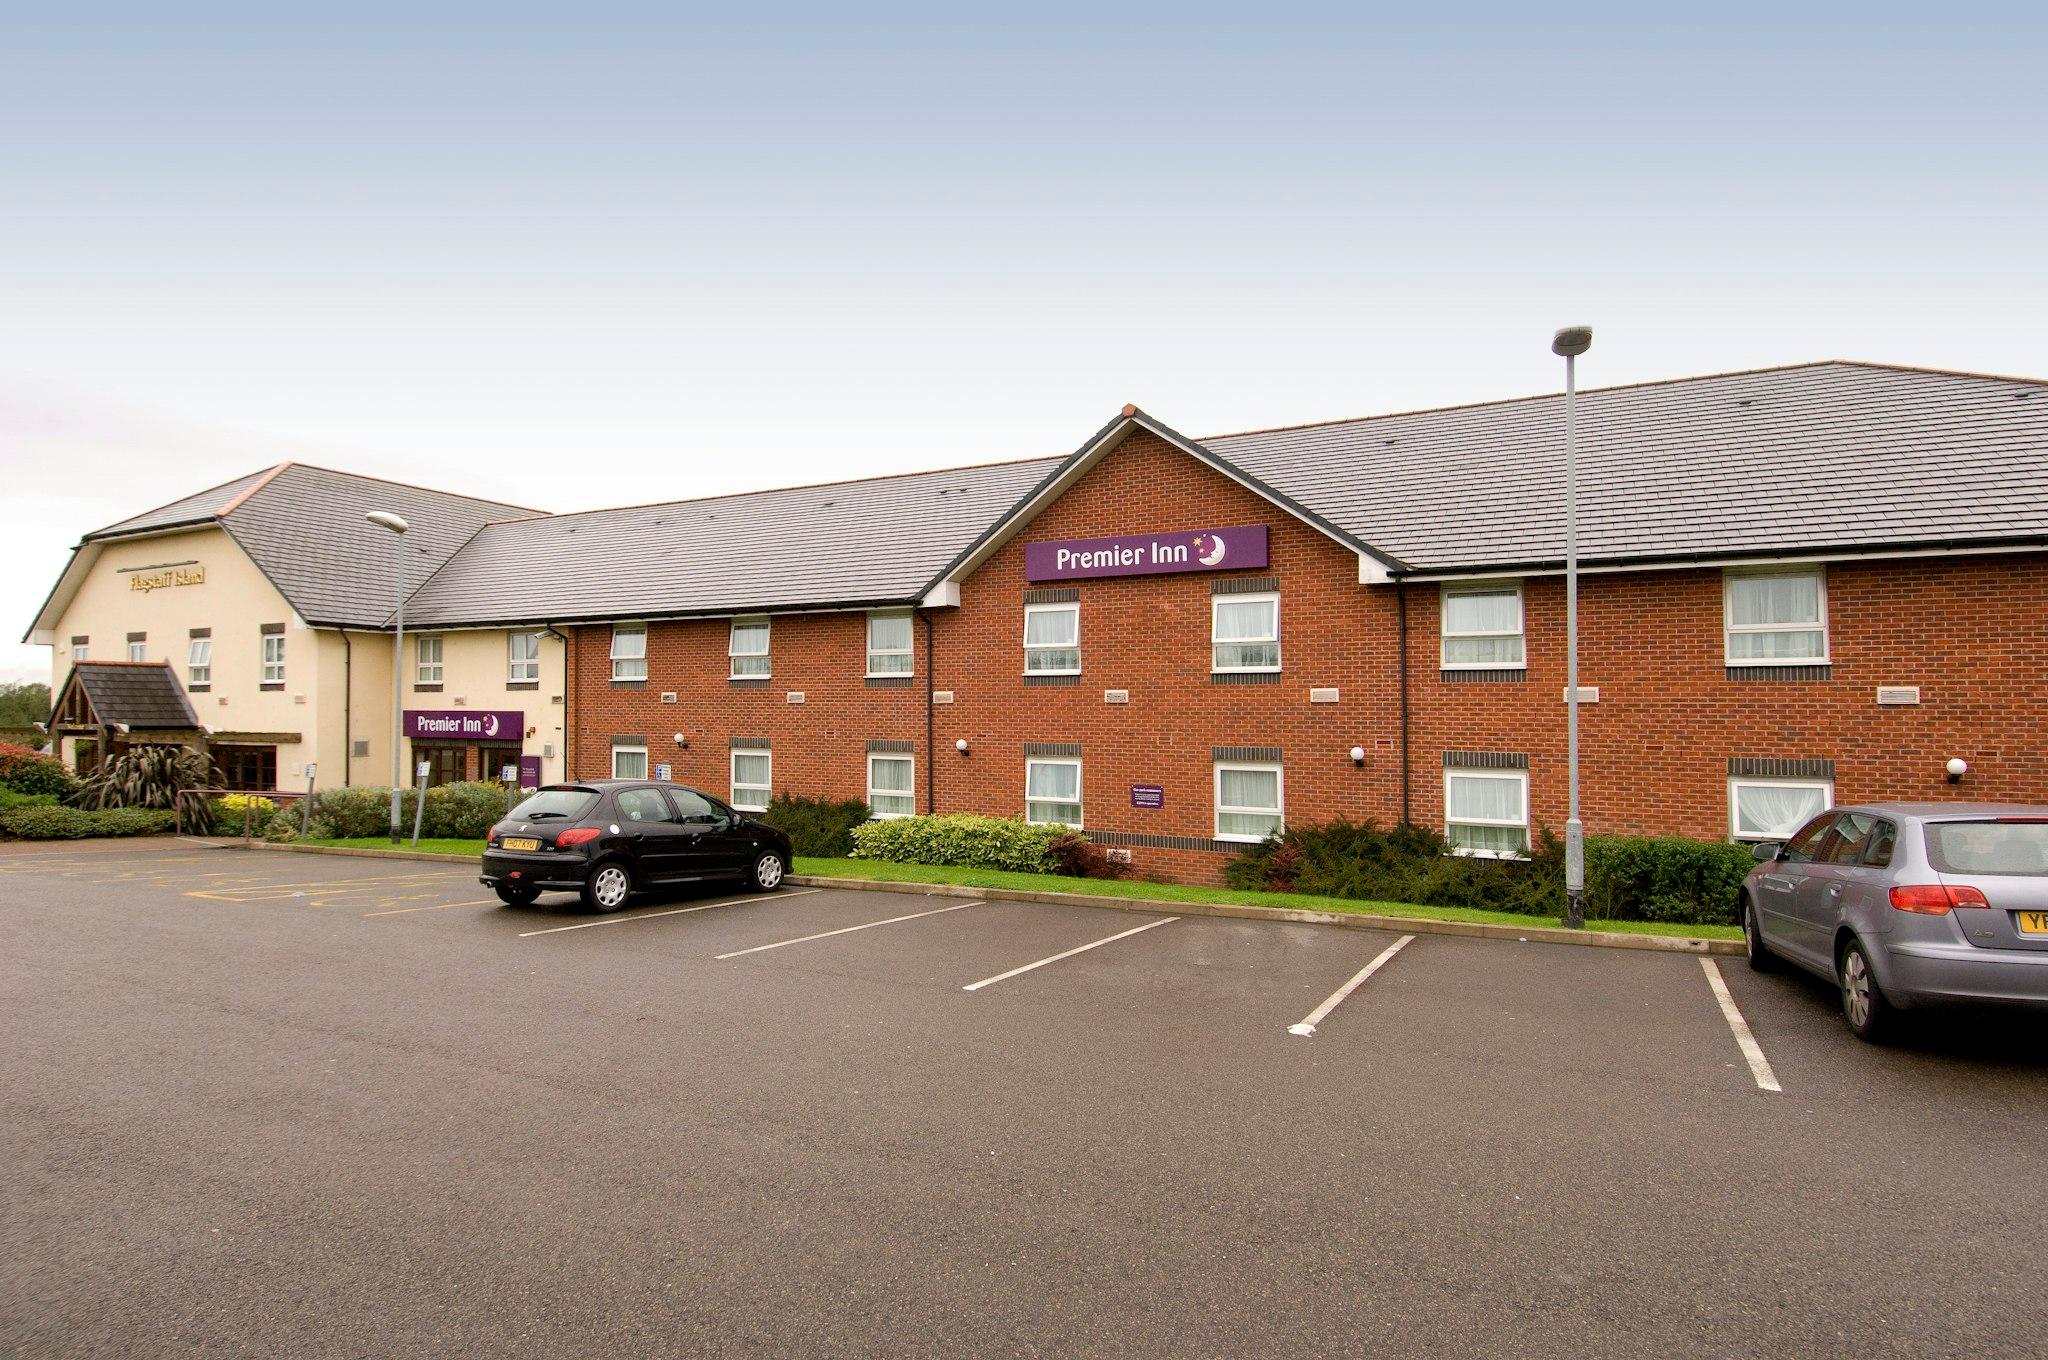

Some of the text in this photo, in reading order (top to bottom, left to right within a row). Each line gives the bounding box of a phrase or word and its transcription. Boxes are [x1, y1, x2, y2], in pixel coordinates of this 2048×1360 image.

[1057, 542, 1188, 570] Premier Inn
[174, 566, 204, 586] Island
[417, 715, 482, 733] Premier Inn
